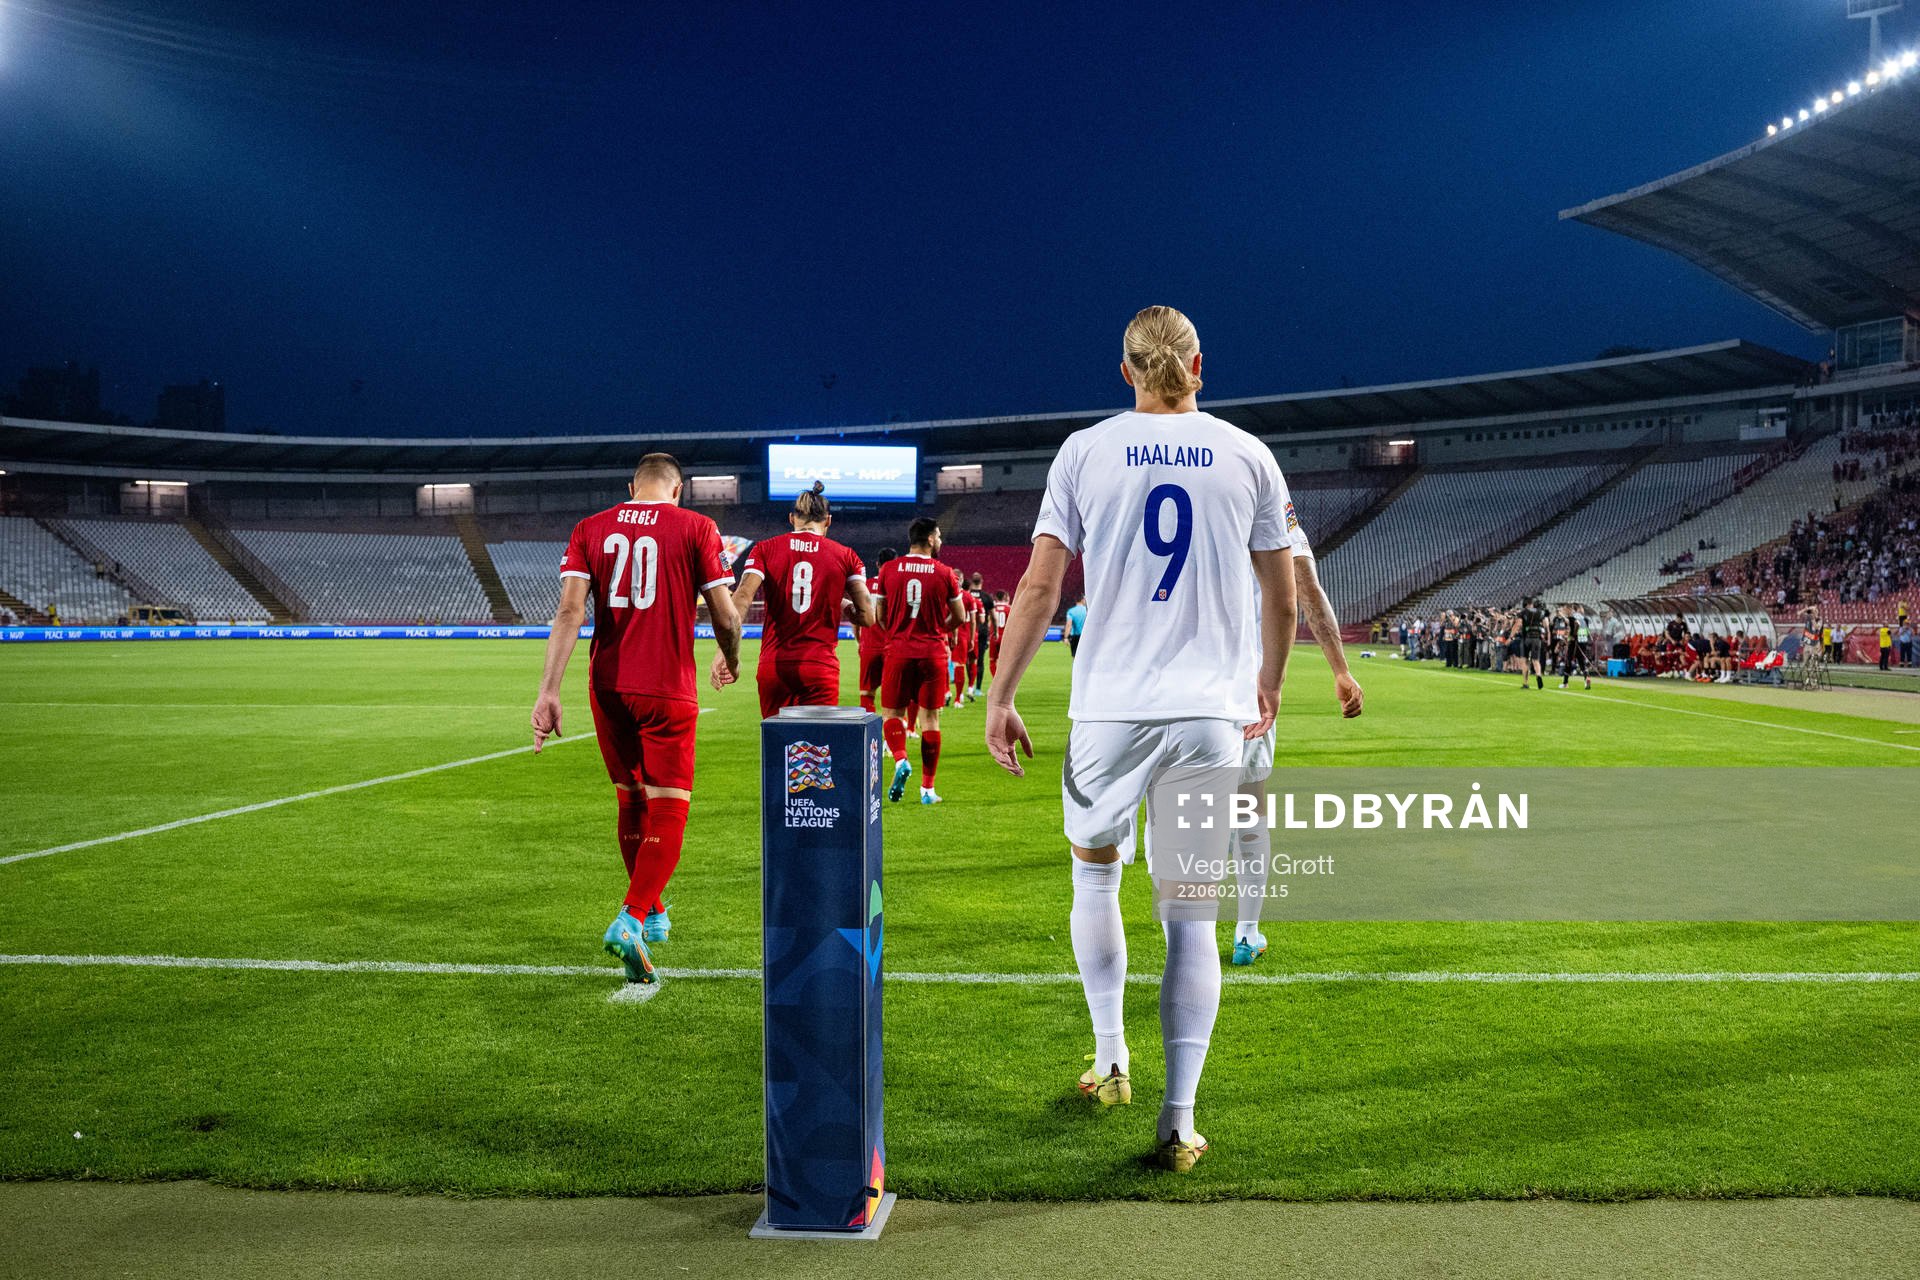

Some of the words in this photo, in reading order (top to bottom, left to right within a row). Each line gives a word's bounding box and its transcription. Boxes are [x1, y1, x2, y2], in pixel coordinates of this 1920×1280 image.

[1126, 444, 1214, 468] HAALAND
[783, 467, 841, 480] PEACE
[617, 509, 659, 526] SERGEJ
[789, 538, 819, 553] GUDELJ
[1143, 483, 1194, 603] 9
[603, 533, 658, 610] 20
[792, 561, 814, 614] 8
[906, 578, 922, 619] 9
[258, 629, 284, 638] PEACE
[333, 629, 357, 637] PEACE
[405, 629, 429, 637] PEACE
[477, 629, 501, 637] PEACE
[791, 798, 815, 807] UEFA
[785, 807, 840, 818] NATIONS
[785, 818, 834, 828] LEAGUE
